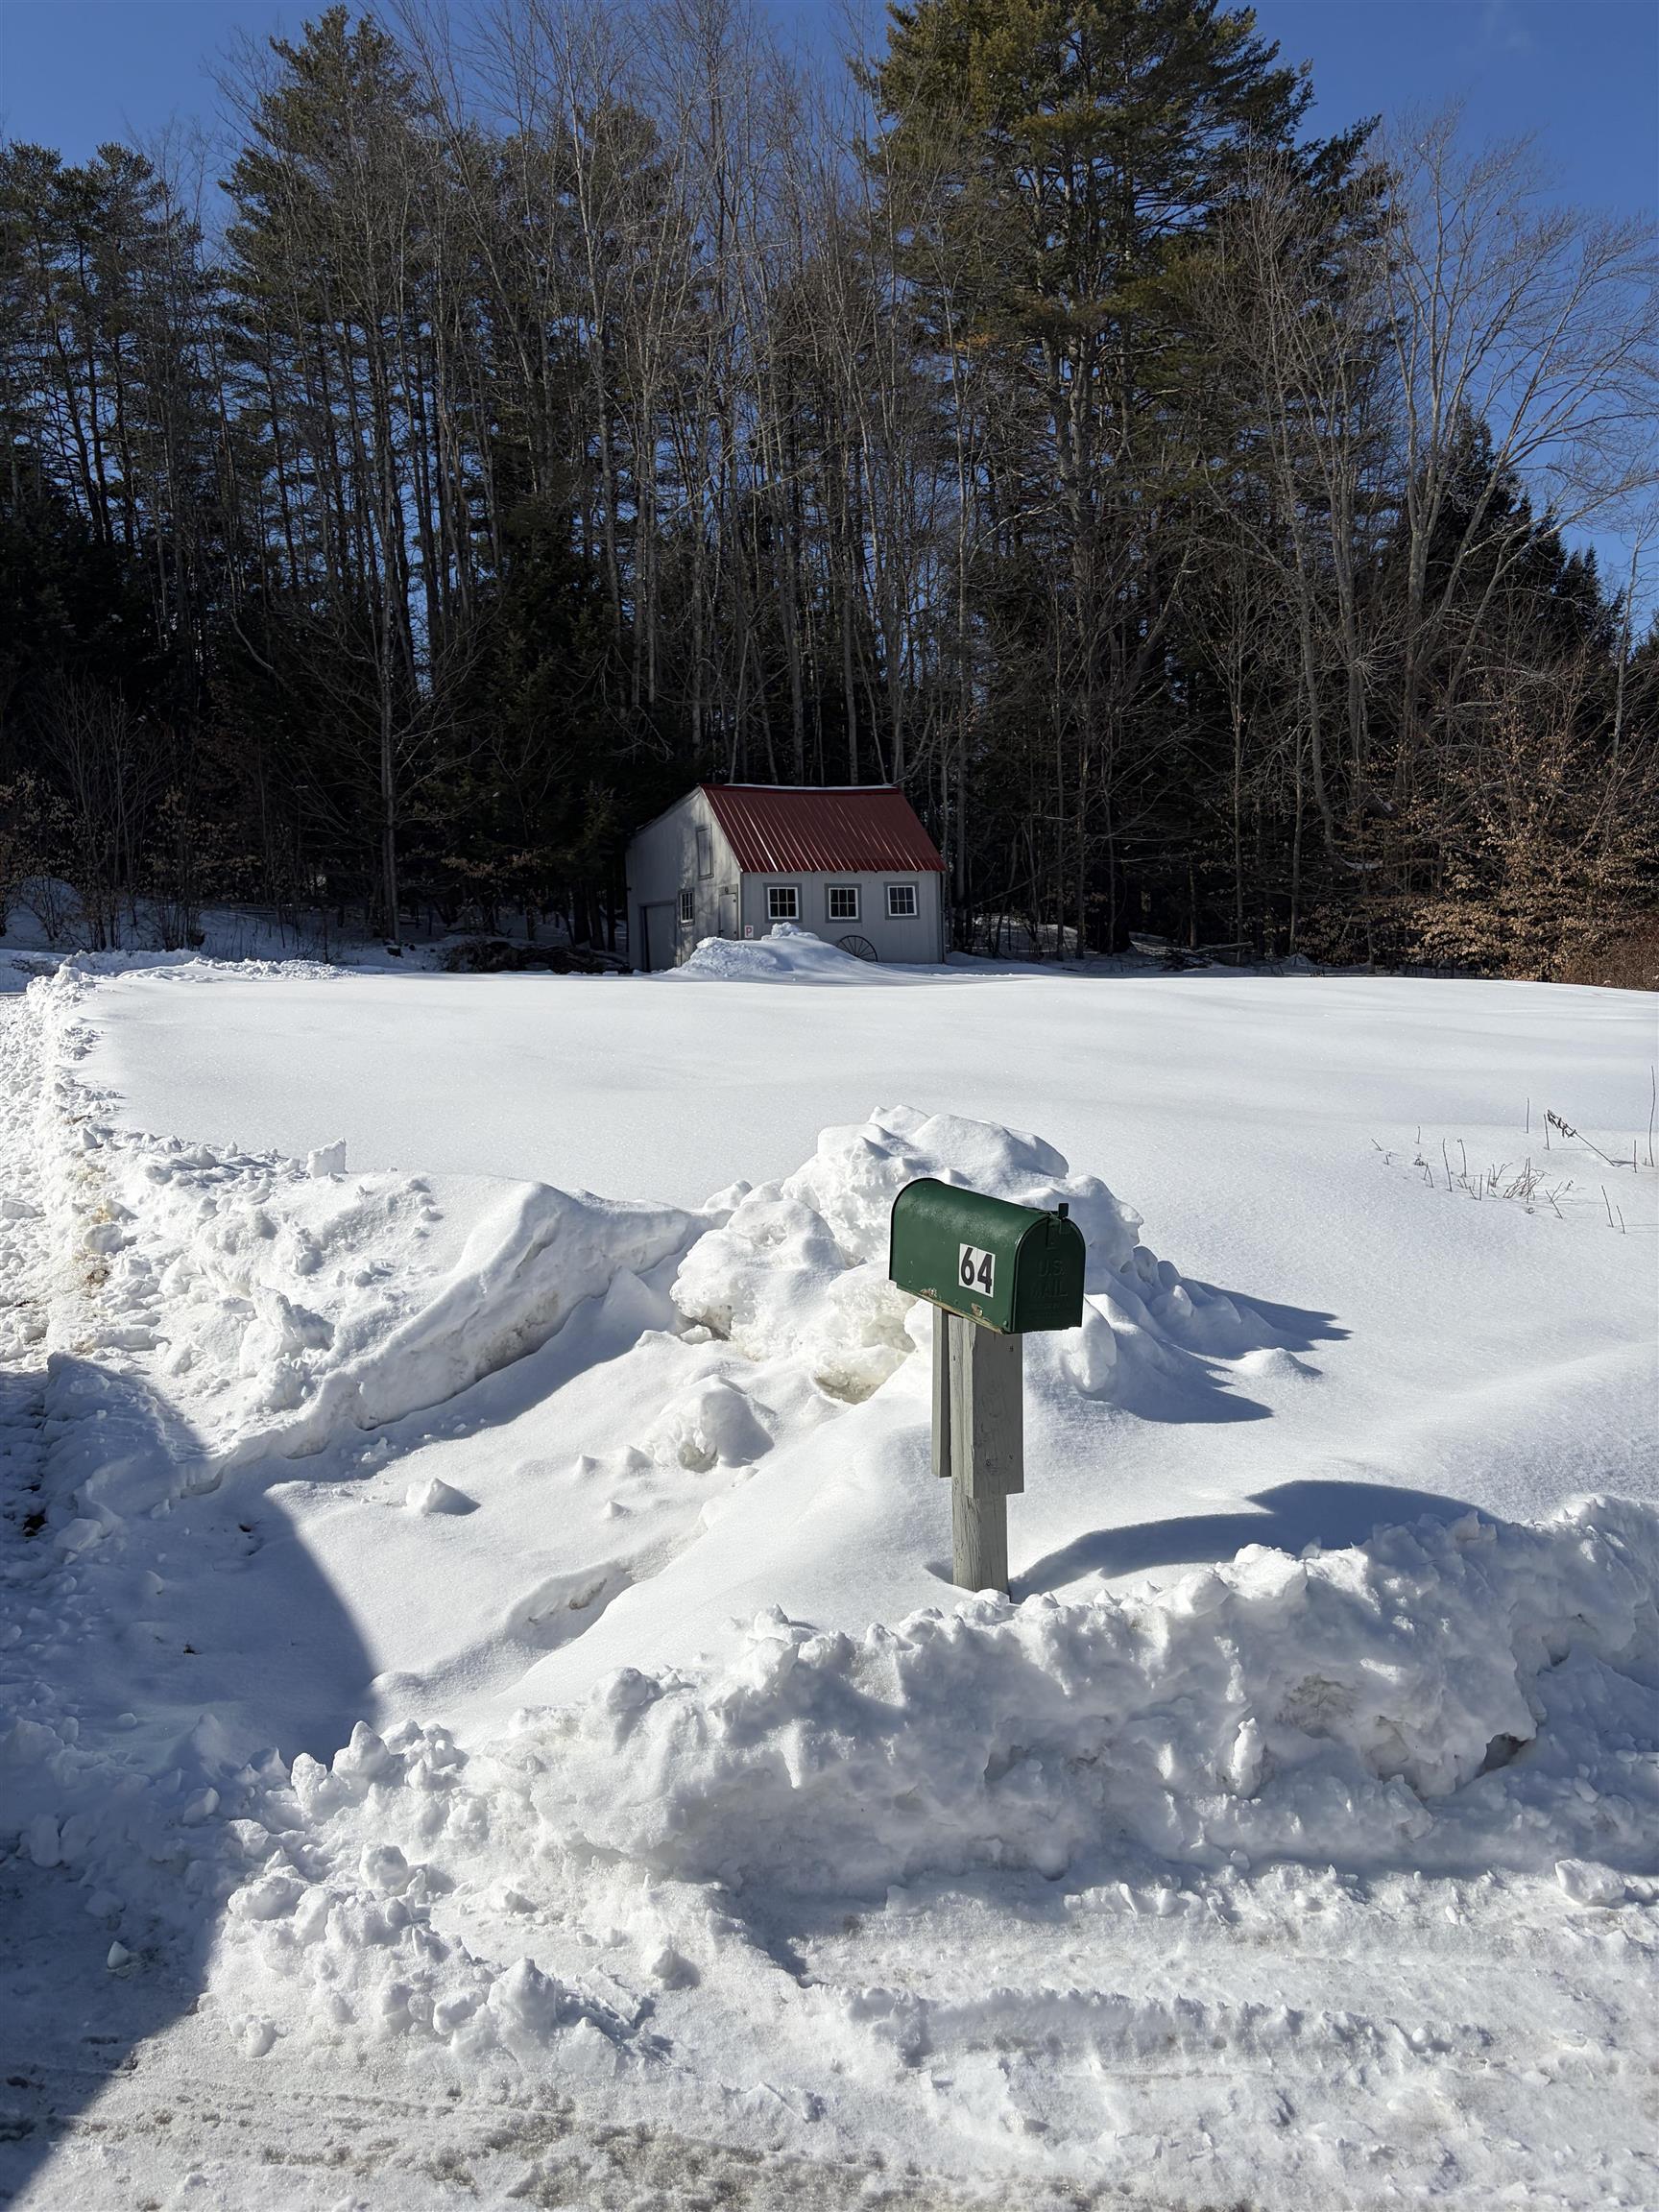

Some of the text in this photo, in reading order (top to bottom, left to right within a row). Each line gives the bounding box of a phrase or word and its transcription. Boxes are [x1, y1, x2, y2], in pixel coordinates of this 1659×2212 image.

[746, 926, 753, 937] P
[960, 1246, 993, 1294] 64
[1037, 1259, 1066, 1276] U.S.
[1030, 1279, 1069, 1298] MAIL
